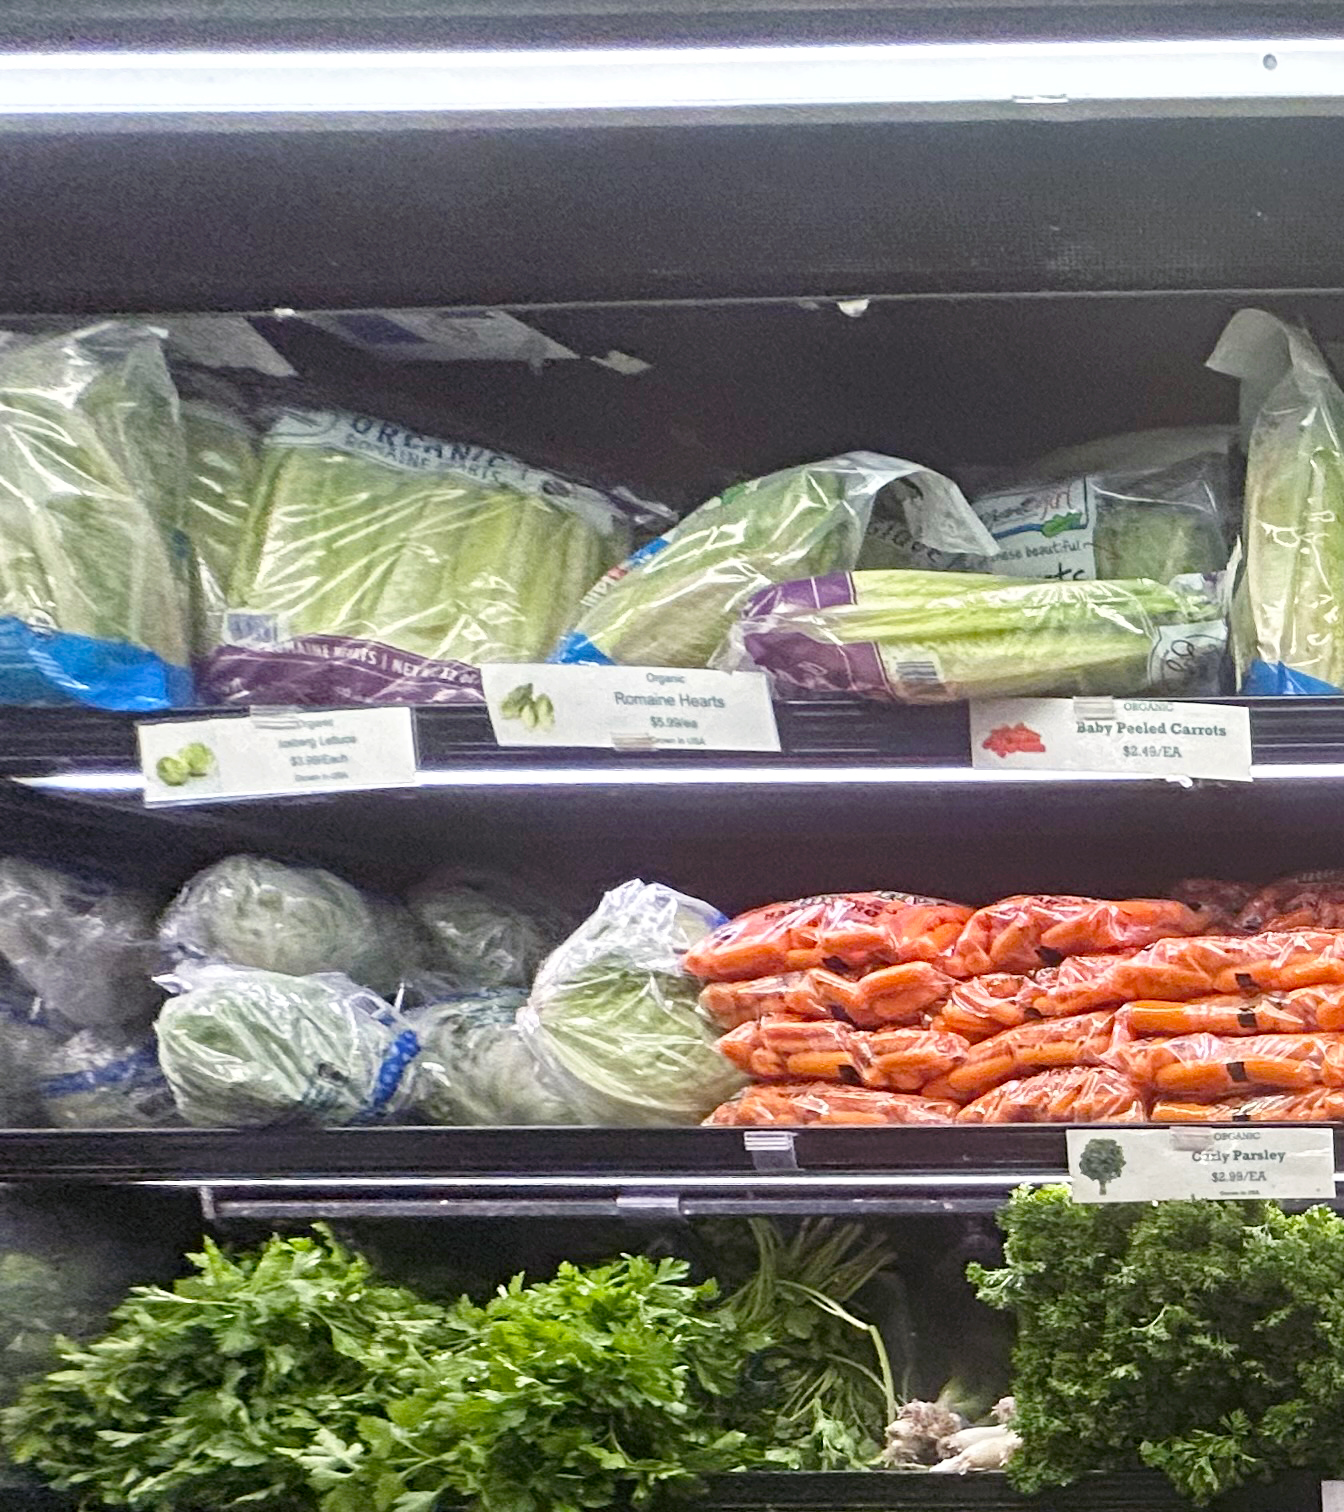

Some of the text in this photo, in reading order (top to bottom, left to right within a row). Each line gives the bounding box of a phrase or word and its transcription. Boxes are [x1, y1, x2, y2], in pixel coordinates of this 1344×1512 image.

[613, 691, 726, 709] Romaine Hearts
[1123, 701, 1174, 713] ORGANIC
[1075, 720, 1227, 737] Baby Peeled Carrots
[1232, 1149, 1286, 1164] Parsley
